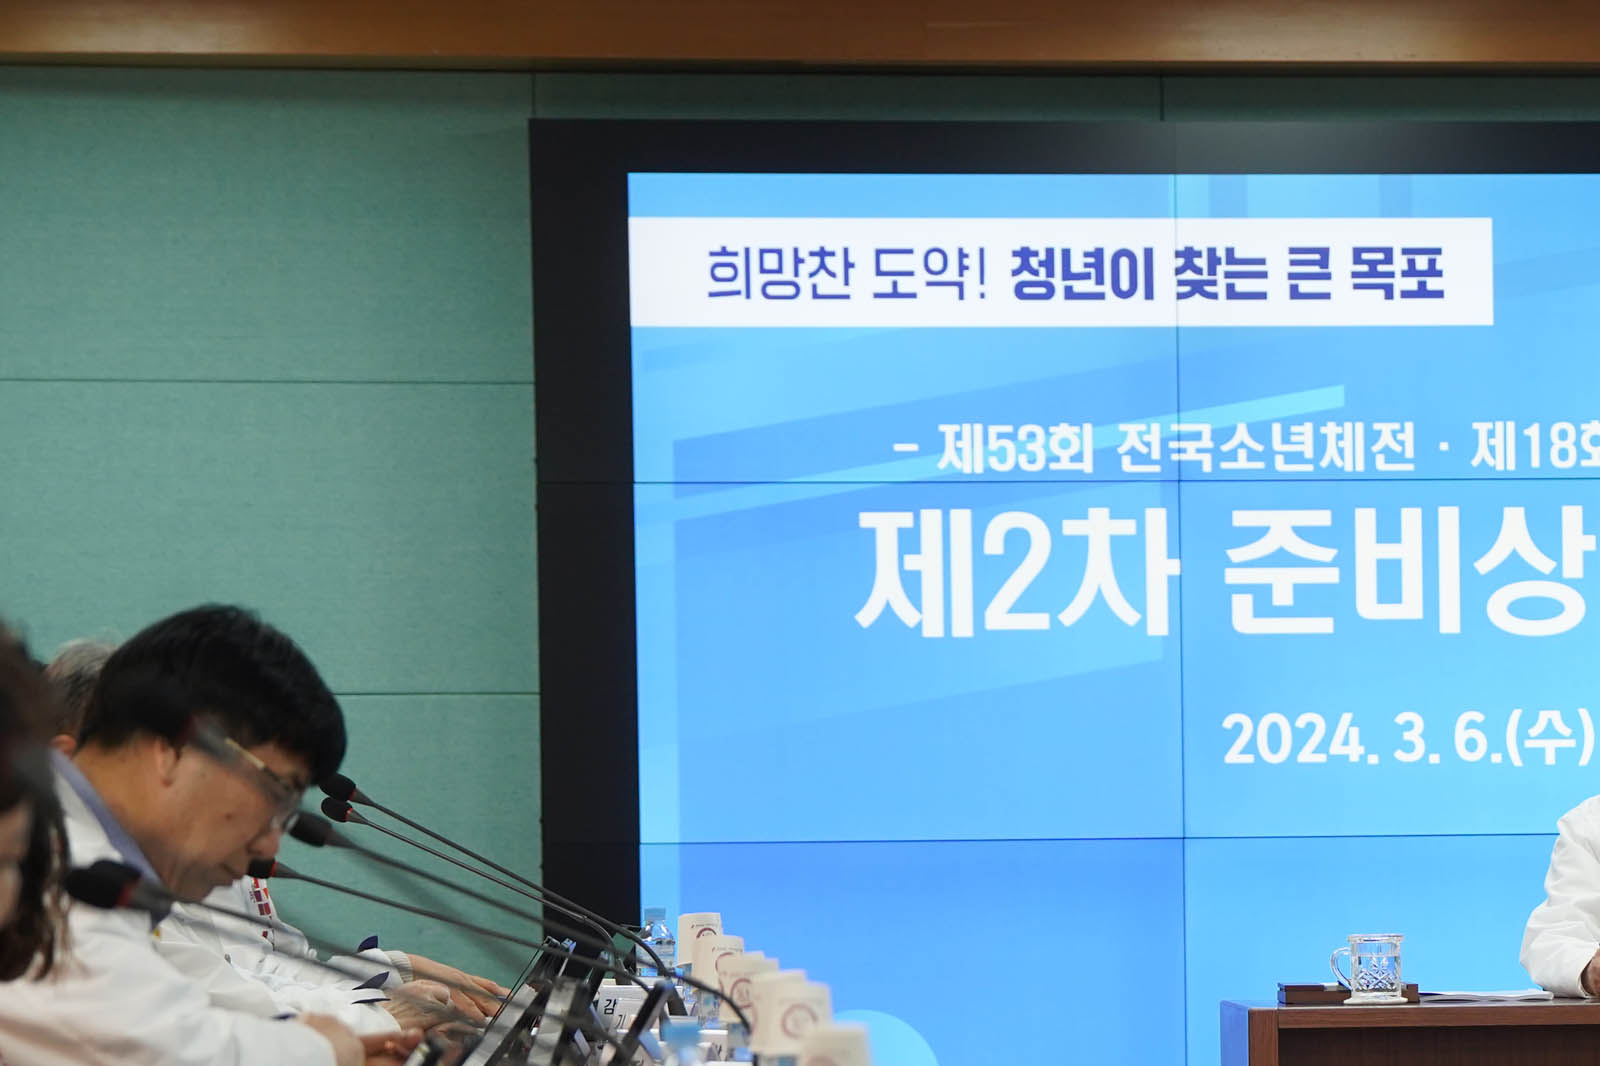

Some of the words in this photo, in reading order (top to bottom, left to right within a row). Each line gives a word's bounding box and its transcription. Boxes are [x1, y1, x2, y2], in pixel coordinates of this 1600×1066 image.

[708, 246, 856, 300] 희망찬
[873, 247, 986, 300] 도약!
[1011, 246, 1155, 301] 청년이
[1175, 246, 1269, 301] 찾는
[1287, 246, 1333, 301] 큰
[1350, 246, 1445, 301] 목포
[937, 422, 1094, 474] 제53회
[1117, 421, 1415, 473] 전국소년체전
[855, 507, 1182, 638] 제2차
[1222, 712, 1379, 765] 2024.
[1394, 711, 1441, 764] 3.
